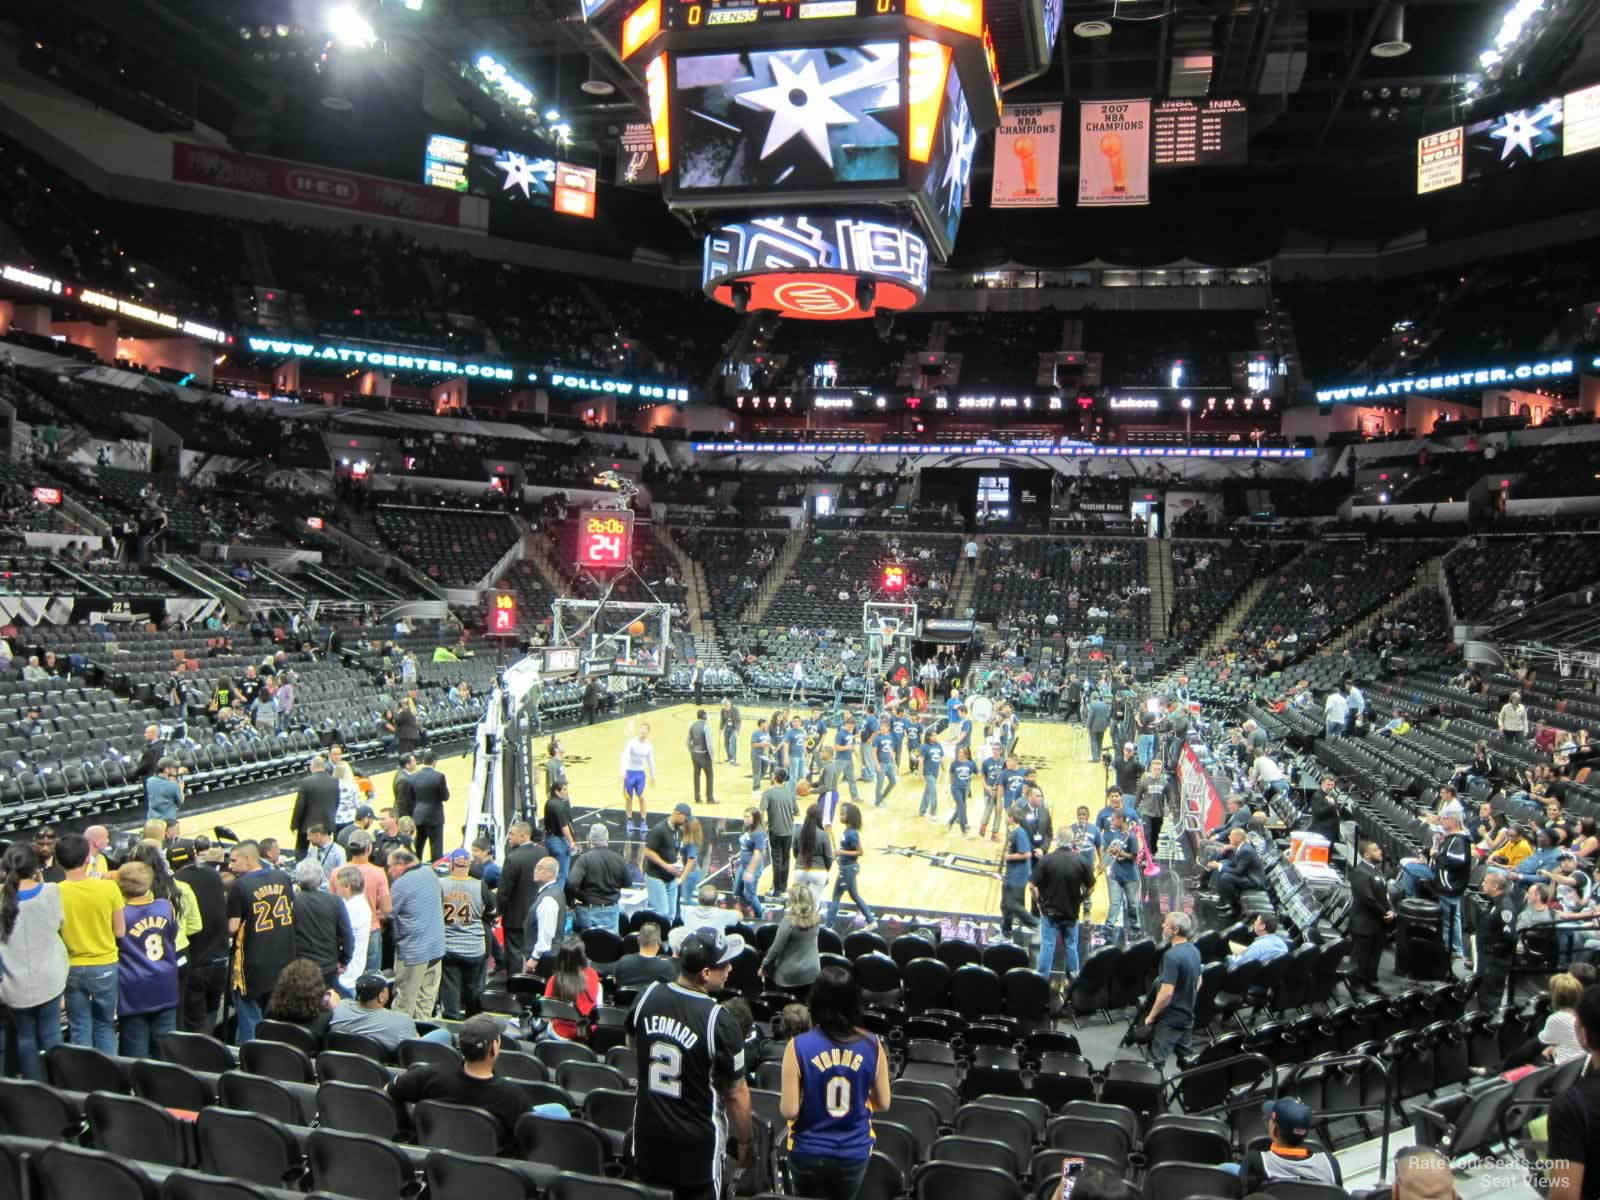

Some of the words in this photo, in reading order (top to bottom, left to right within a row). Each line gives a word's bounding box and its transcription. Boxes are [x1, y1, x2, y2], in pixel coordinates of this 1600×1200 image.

[1101, 105, 1128, 113] 2007
[1105, 114, 1124, 122] NBA
[1000, 125, 1056, 134] CHAMPIONS
[1018, 118, 1037, 126] NBA
[1086, 122, 1144, 131] CHAMPIONS
[624, 144, 653, 152] 1999
[249, 337, 513, 380] WWW.ATTCENTER.COM
[552, 374, 633, 395] FOLLOW
[640, 386, 663, 398] US
[1316, 360, 1573, 402] WWW.ATTCENTER.COM
[587, 518, 624, 534] 26:06
[589, 535, 620, 560] 24
[253, 896, 292, 932] 24
[443, 903, 471, 926] 24
[145, 933, 164, 962] 8
[644, 1015, 698, 1050] LEONARD
[648, 1041, 682, 1098] 2
[811, 1048, 864, 1073] YOUNG
[826, 1076, 851, 1118] 0
